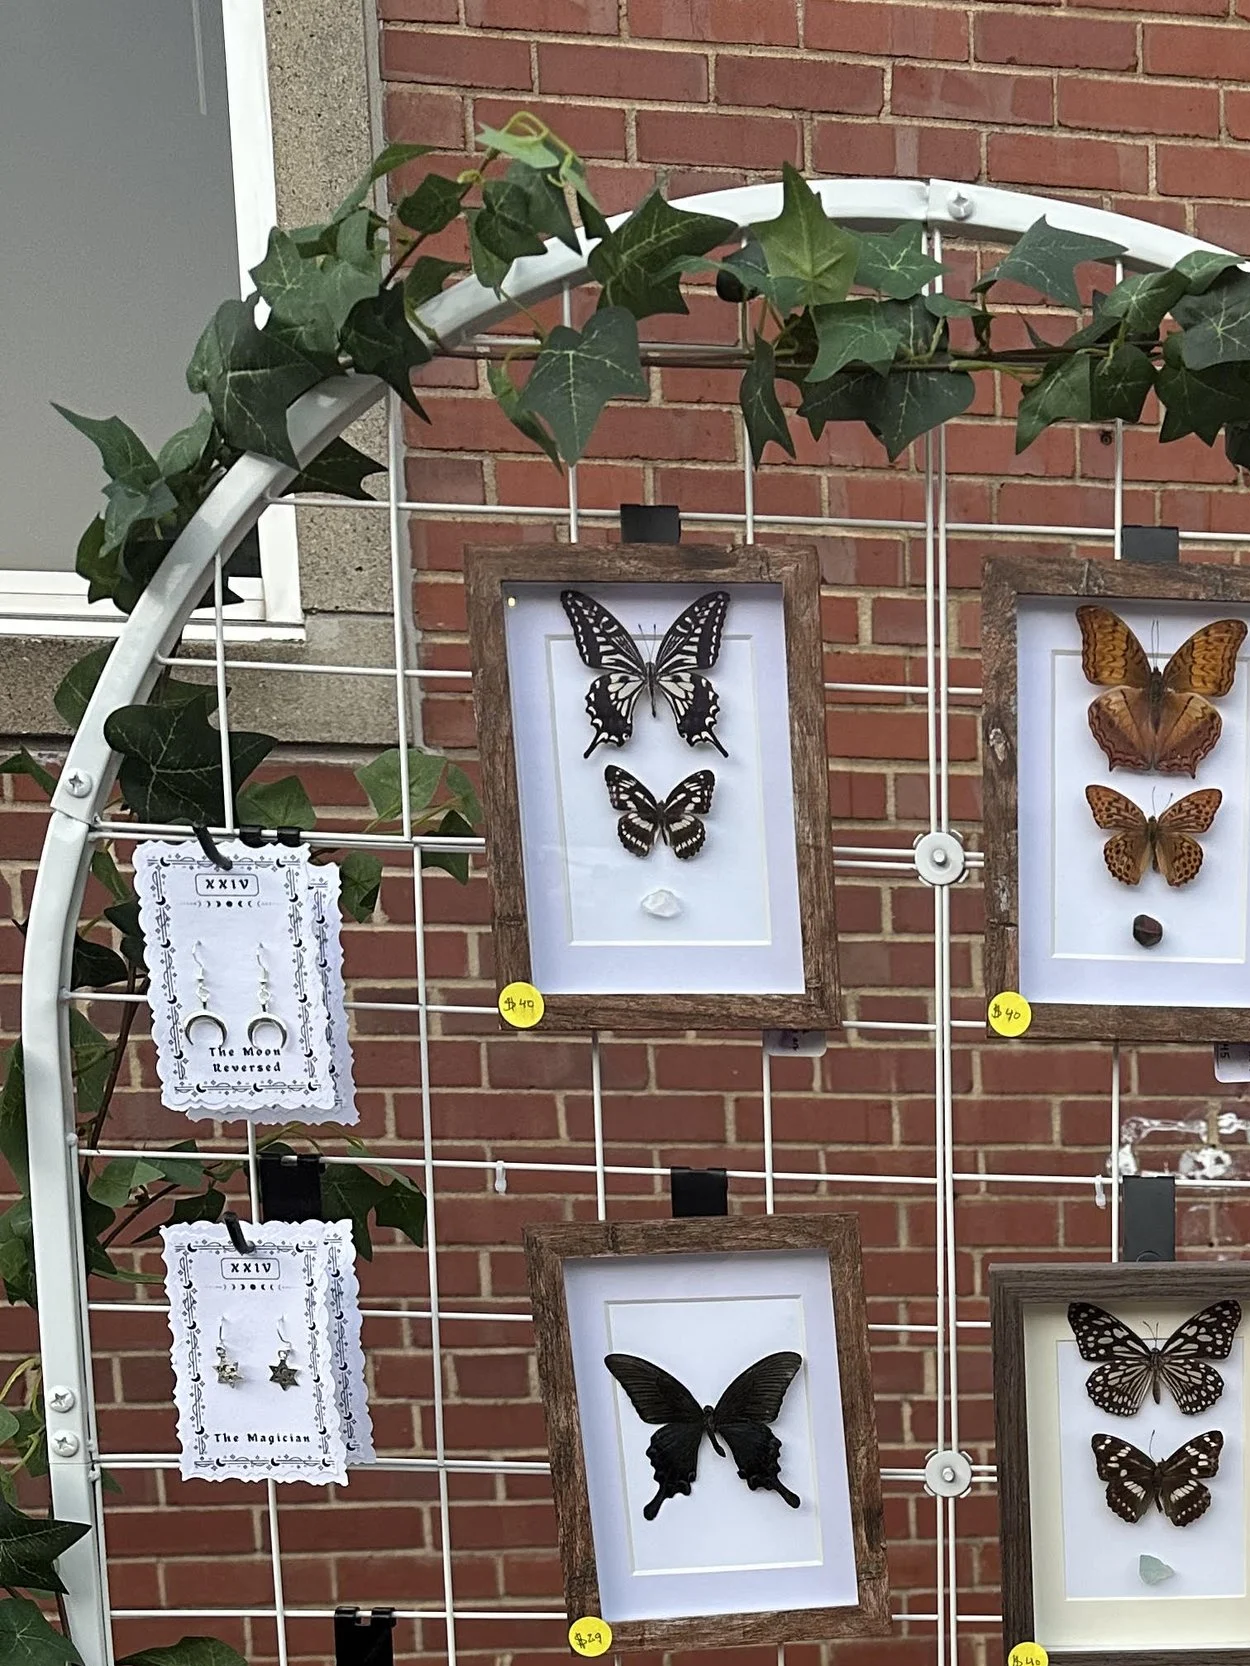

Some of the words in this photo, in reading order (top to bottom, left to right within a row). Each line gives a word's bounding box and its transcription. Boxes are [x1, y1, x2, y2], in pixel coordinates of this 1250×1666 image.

[206, 879, 249, 890] XXIV
[209, 1047, 236, 1057] The
[243, 1046, 282, 1057] Moon
[213, 1061, 282, 1073] Reversed
[231, 1262, 272, 1273] XXIV
[214, 1433, 240, 1443] The
[247, 1433, 312, 1444] Magician
